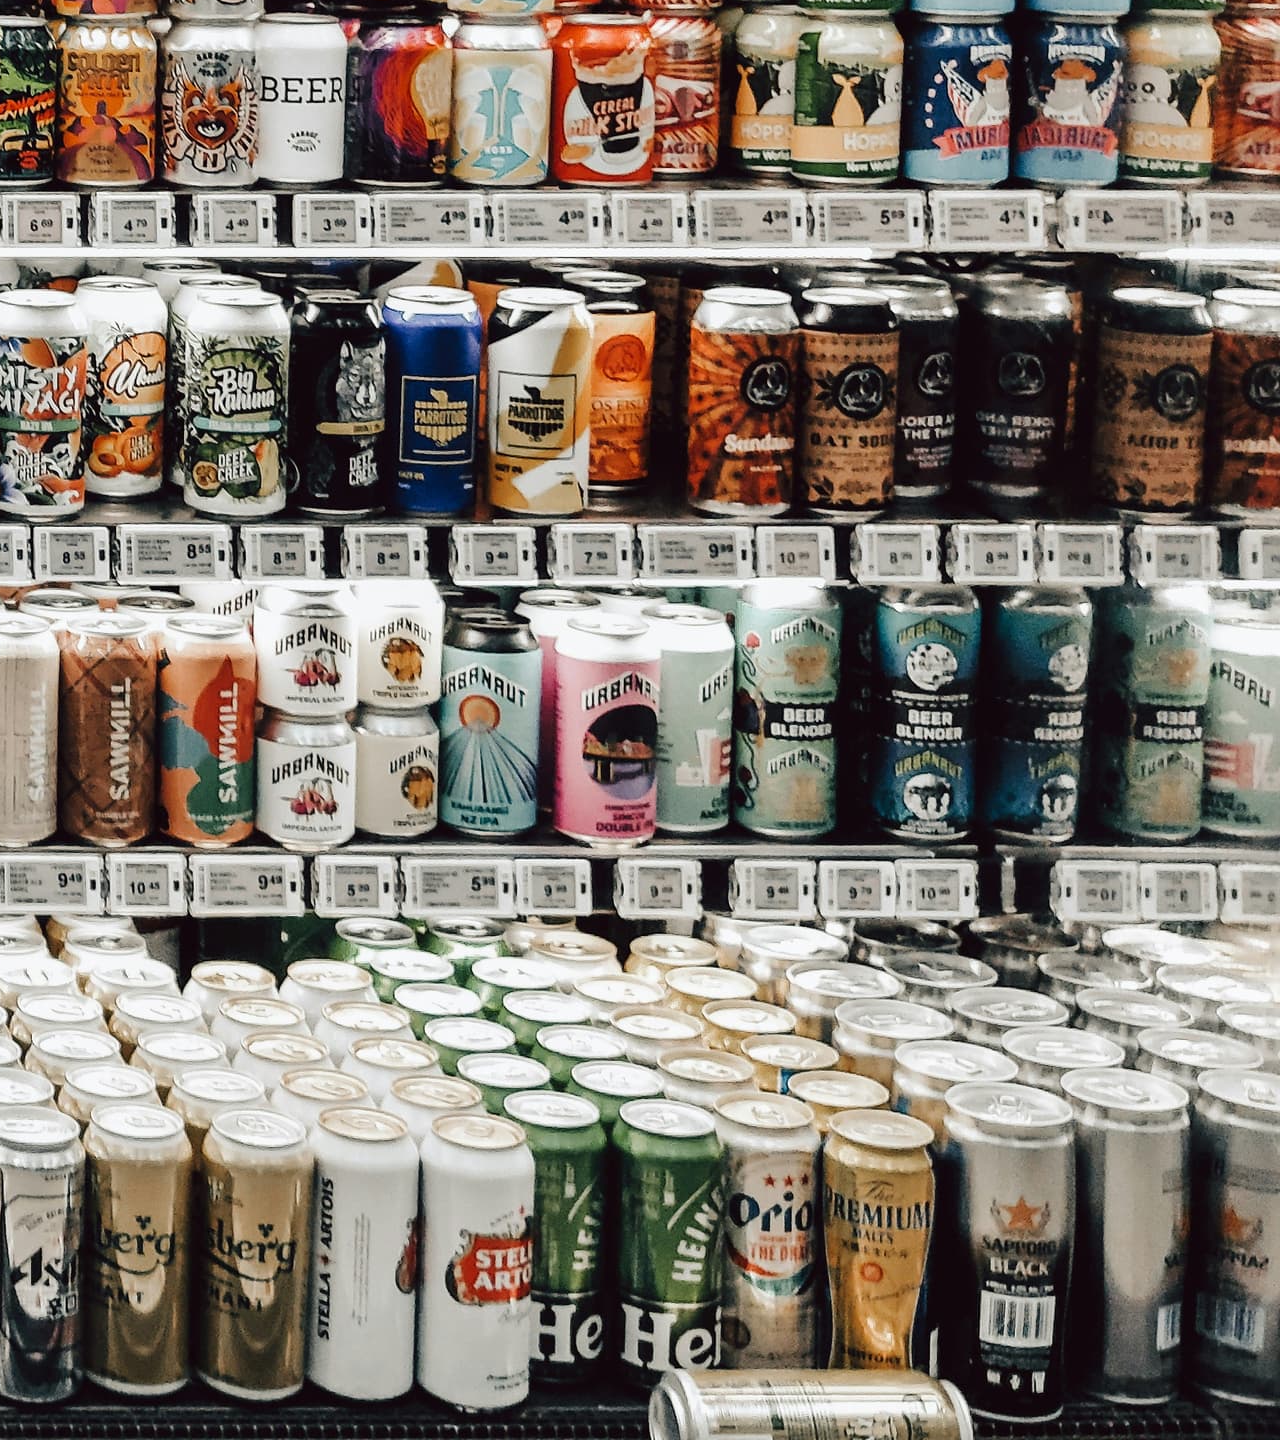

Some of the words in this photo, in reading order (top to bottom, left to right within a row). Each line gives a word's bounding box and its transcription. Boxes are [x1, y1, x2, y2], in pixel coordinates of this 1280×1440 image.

[261, 76, 345, 105] BEER
[593, 99, 635, 114] CEREAL
[222, 367, 255, 393] Big
[207, 388, 276, 416] Kahuna
[509, 407, 565, 422] PARROTDOG
[414, 411, 469, 426] PARROTDOG
[276, 623, 354, 658] URBANAUT
[442, 667, 527, 708] URBANAUT
[770, 723, 833, 738] BLENDER
[908, 709, 953, 725] BEER
[111, 677, 133, 801] SAWMILL
[218, 681, 240, 803] SAWMILL
[896, 724, 963, 741] BLENDER
[320, 1176, 335, 1251] ARTOIS
[730, 1191, 813, 1234] Orio
[827, 1195, 933, 1231] PREMIUM
[982, 1236, 1058, 1257] SAPPORO
[991, 1257, 1050, 1277] BLACK
[317, 1273, 334, 1340] STELLA
